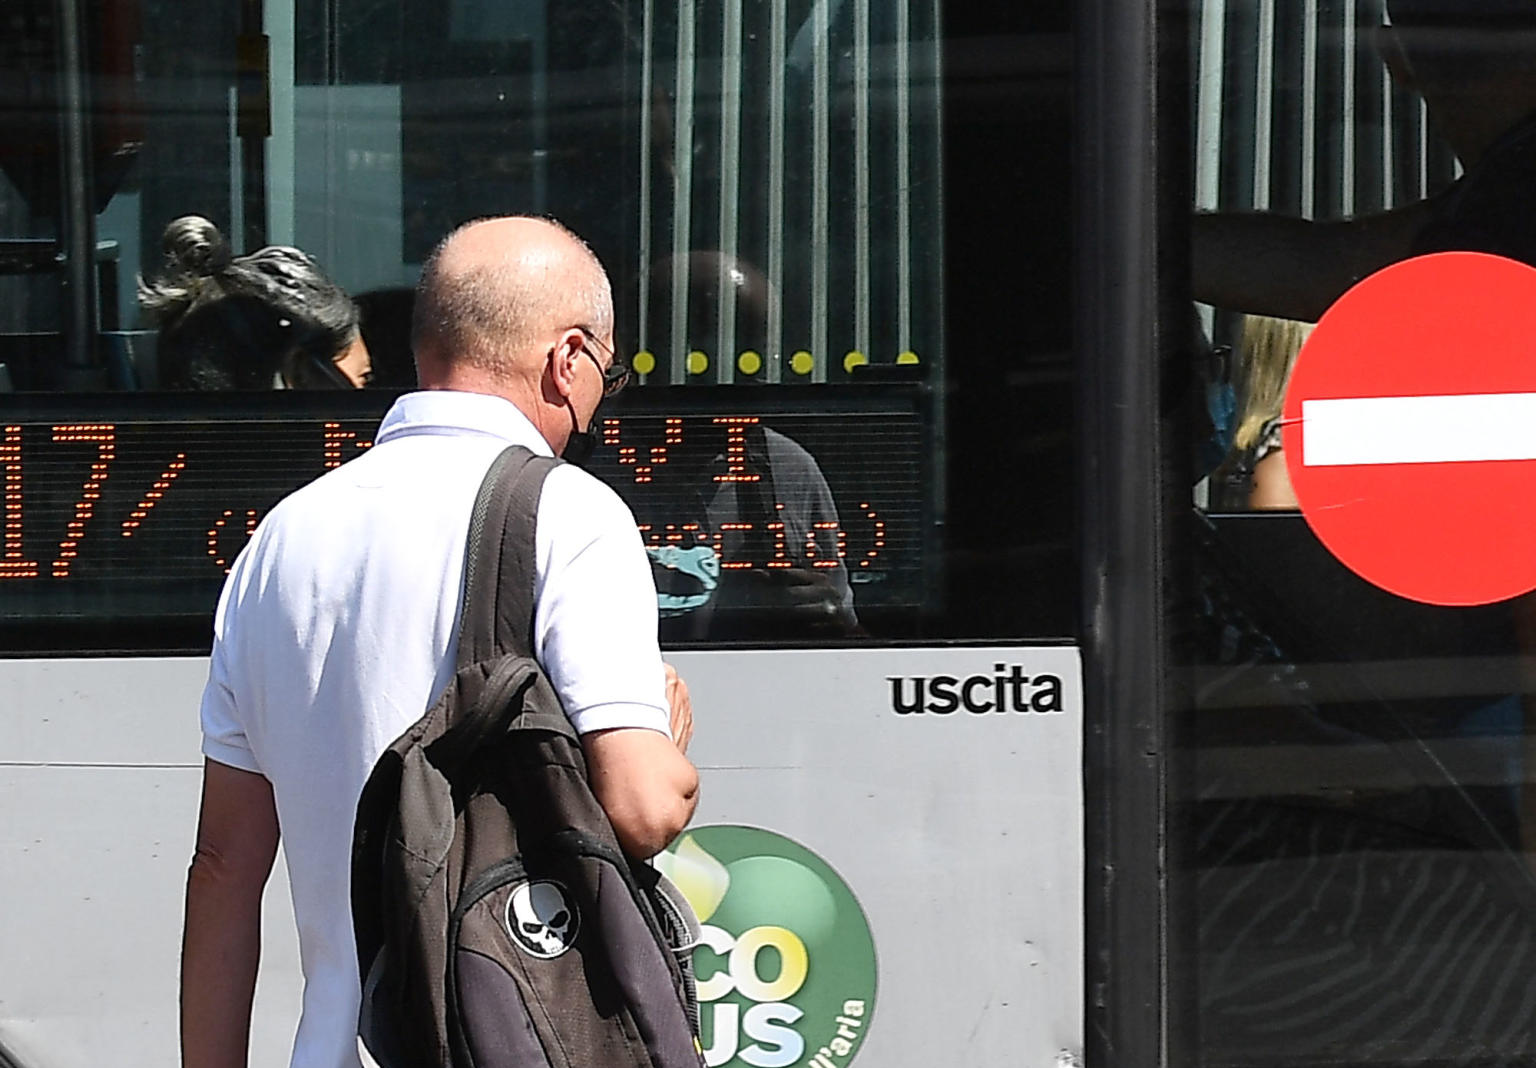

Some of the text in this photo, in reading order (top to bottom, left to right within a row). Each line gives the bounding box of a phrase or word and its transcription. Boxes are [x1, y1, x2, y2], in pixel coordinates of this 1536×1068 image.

[886, 663, 1064, 714] uscita
[693, 924, 808, 1002] CO
[698, 1002, 805, 1068] US
